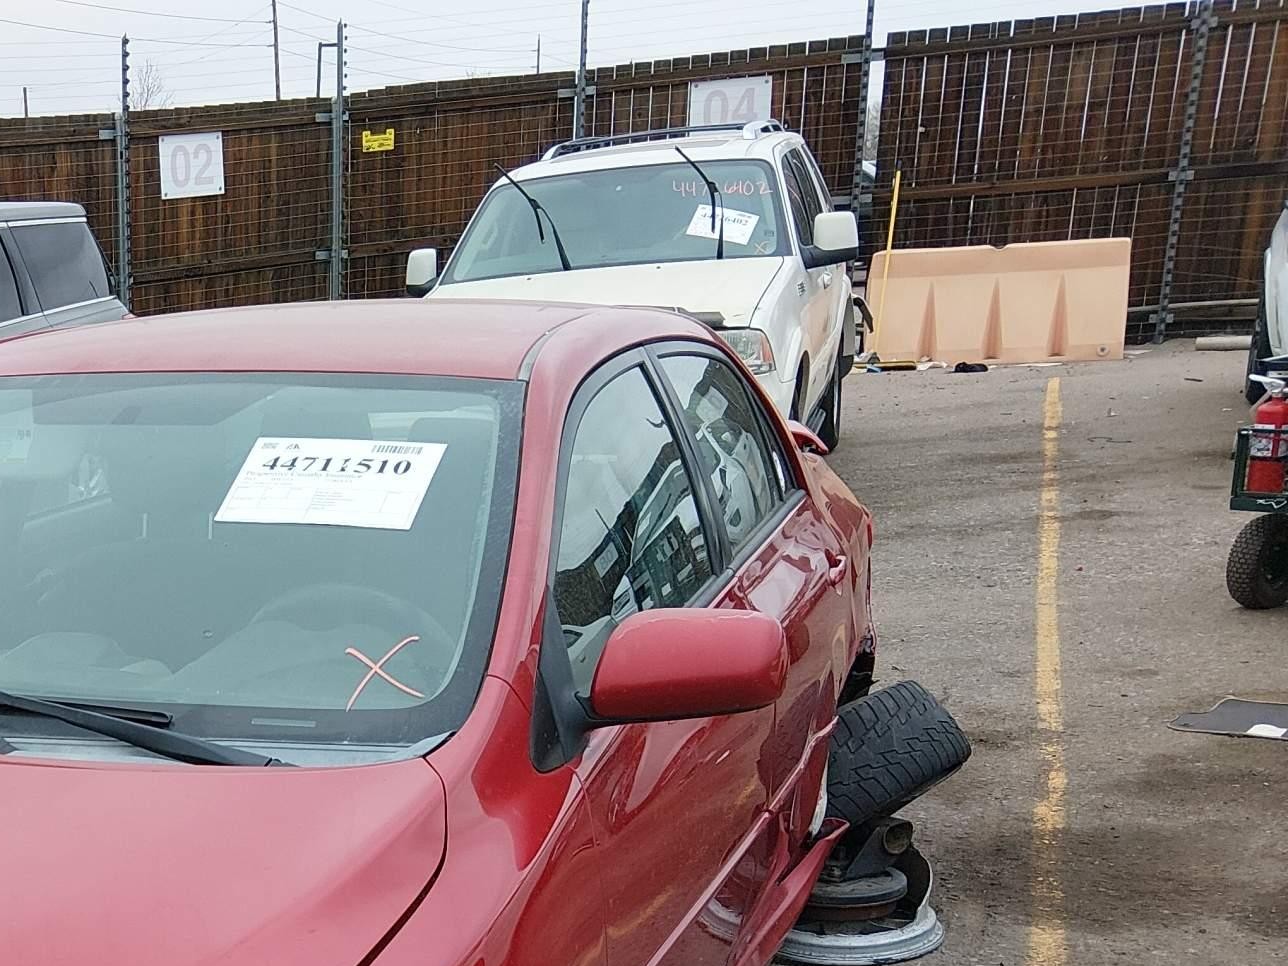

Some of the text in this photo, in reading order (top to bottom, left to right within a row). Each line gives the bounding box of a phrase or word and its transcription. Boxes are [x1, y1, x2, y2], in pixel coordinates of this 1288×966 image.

[703, 87, 758, 125] 04
[170, 143, 215, 188] 02
[672, 179, 774, 197] 4476402
[262, 455, 412, 476] 44711510
